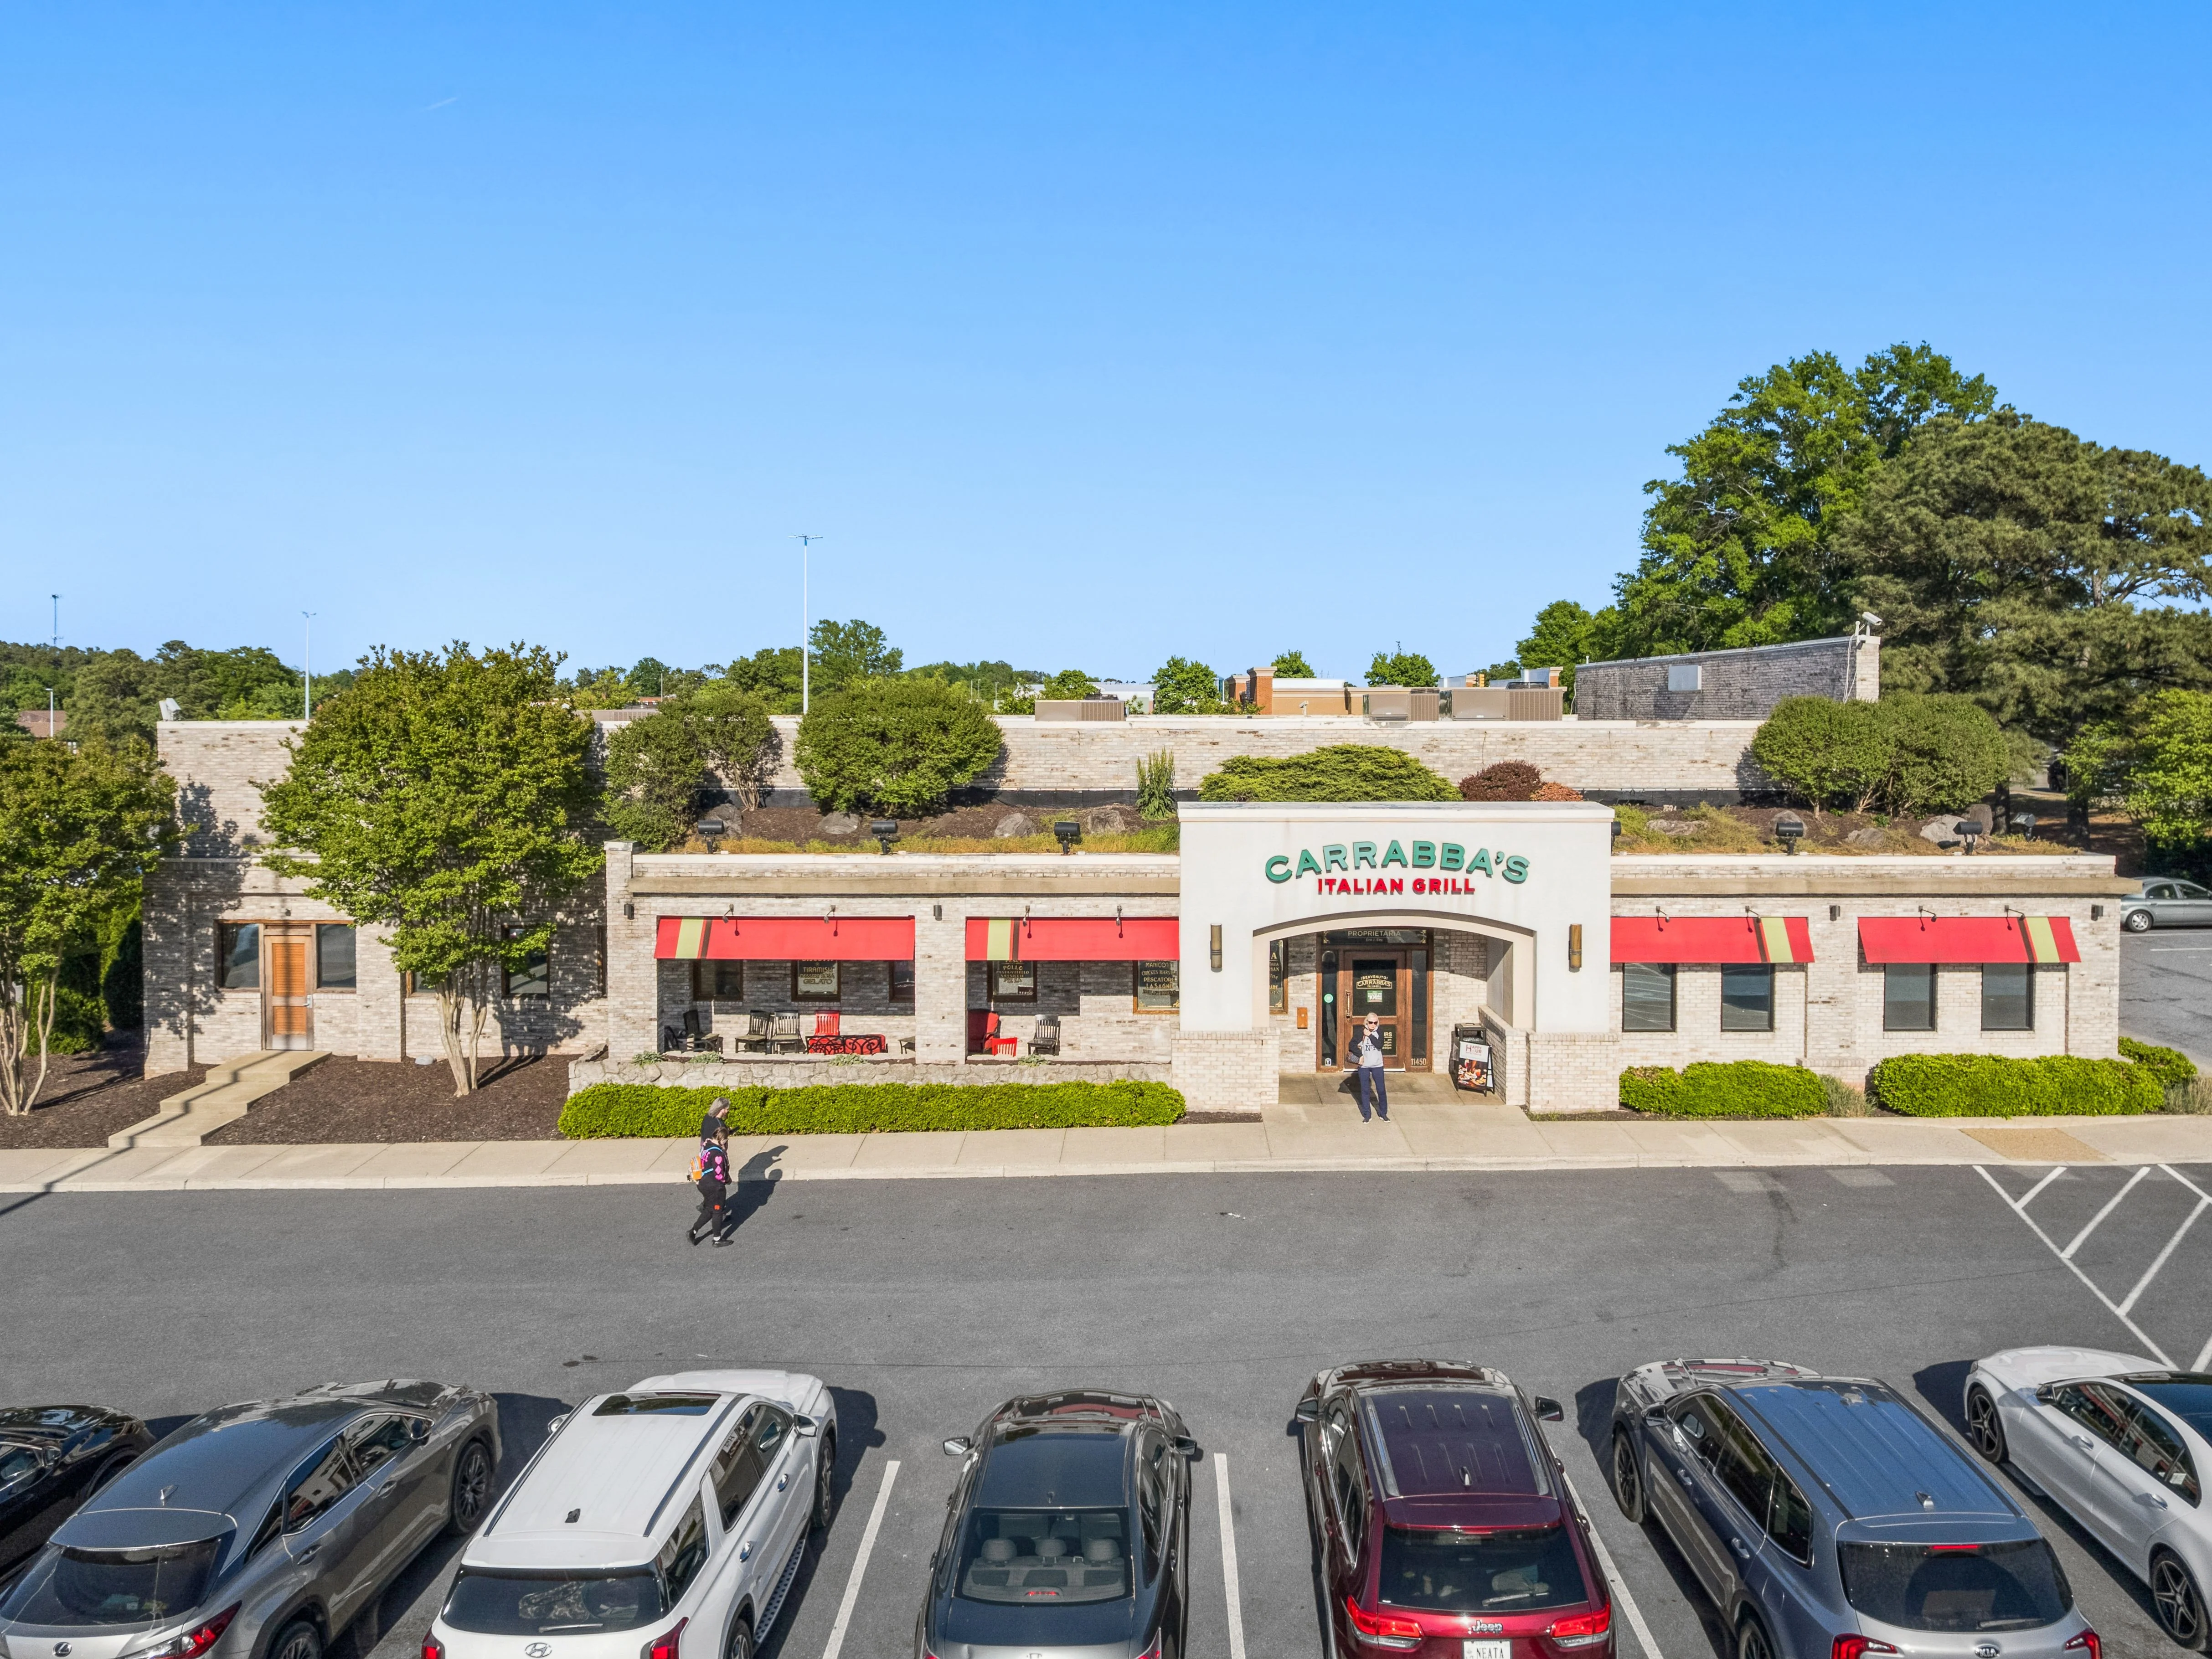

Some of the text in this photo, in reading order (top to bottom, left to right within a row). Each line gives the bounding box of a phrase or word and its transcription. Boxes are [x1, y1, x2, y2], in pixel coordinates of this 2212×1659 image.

[1265, 840, 1530, 885] CARRABBA'S
[1318, 878, 1475, 895] ITALIAN GRILL
[1472, 1619, 1503, 1634] Jeep
[1476, 1648, 1504, 1659] NEATA
[1980, 1648, 1997, 1657] KIA
